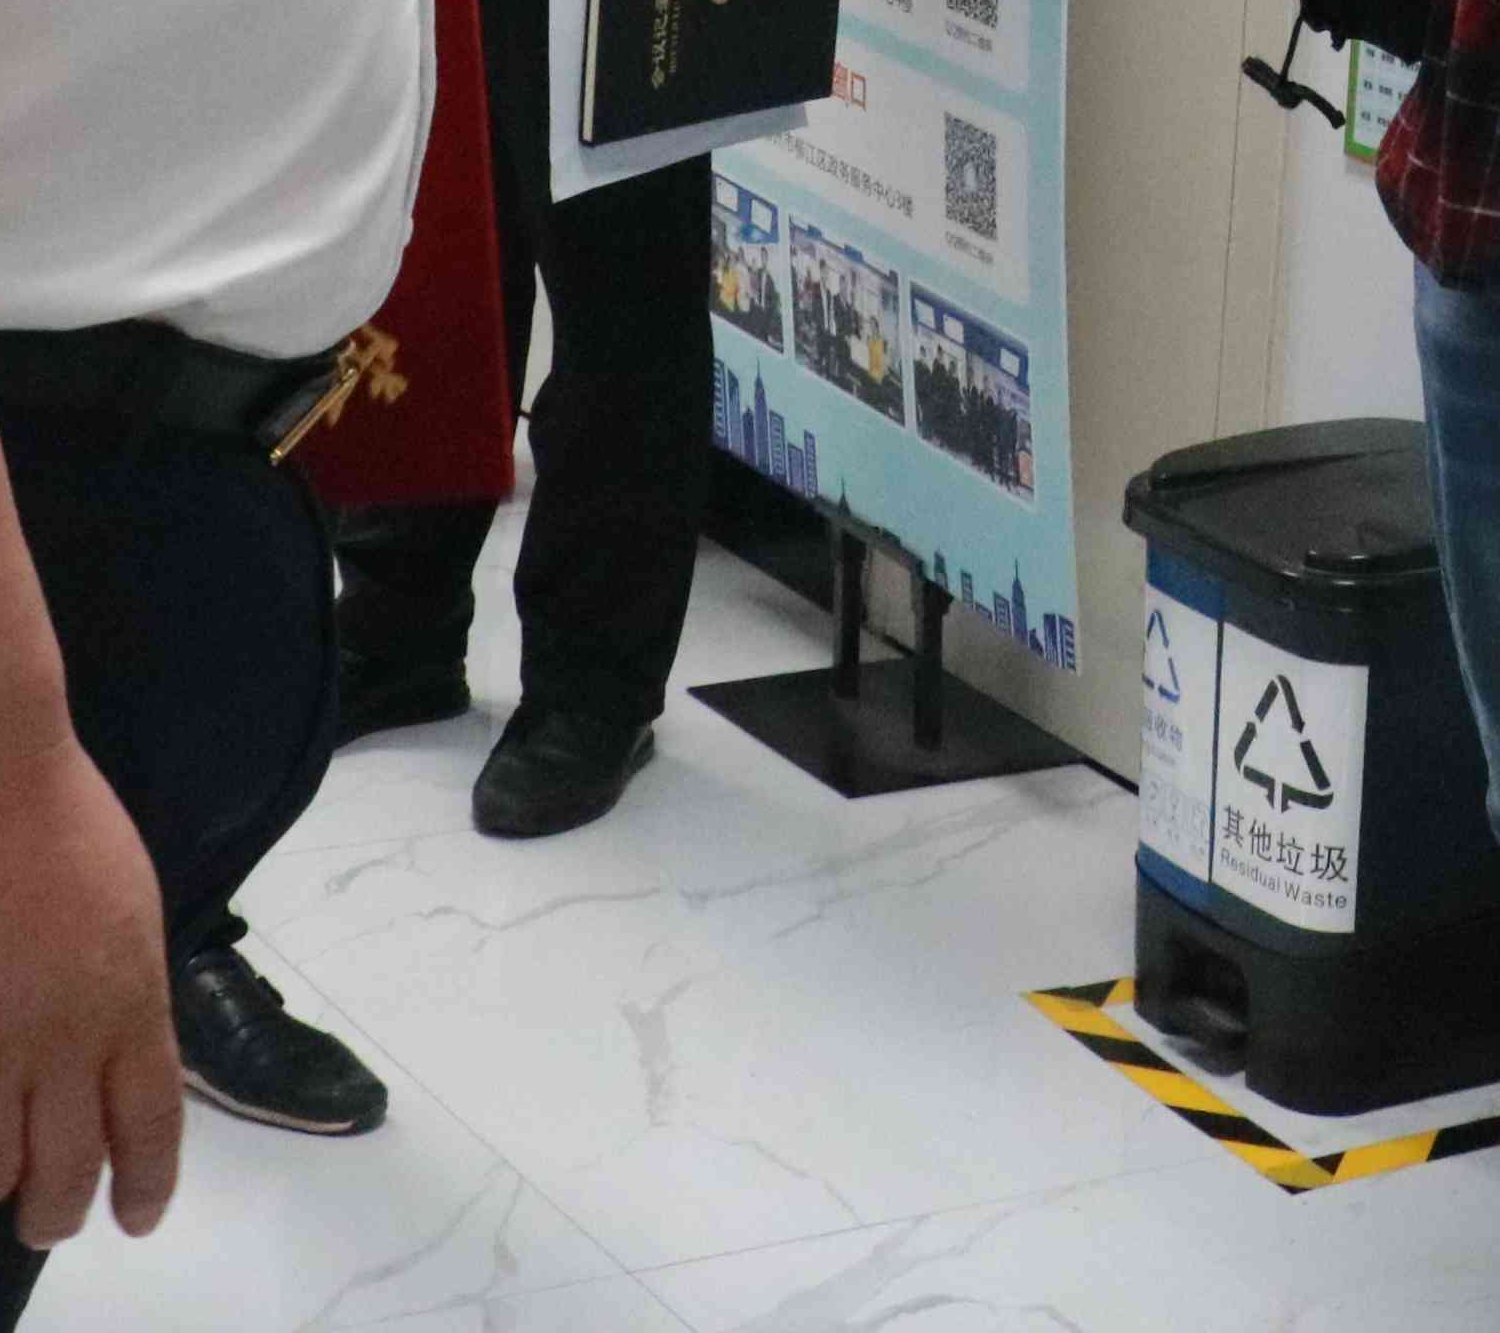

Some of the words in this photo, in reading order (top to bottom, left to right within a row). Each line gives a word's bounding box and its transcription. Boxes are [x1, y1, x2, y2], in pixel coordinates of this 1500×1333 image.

[1219, 847, 1281, 892] Residual
[1284, 880, 1349, 911] Waste
[1221, 804, 1350, 884] 其他垃圾
